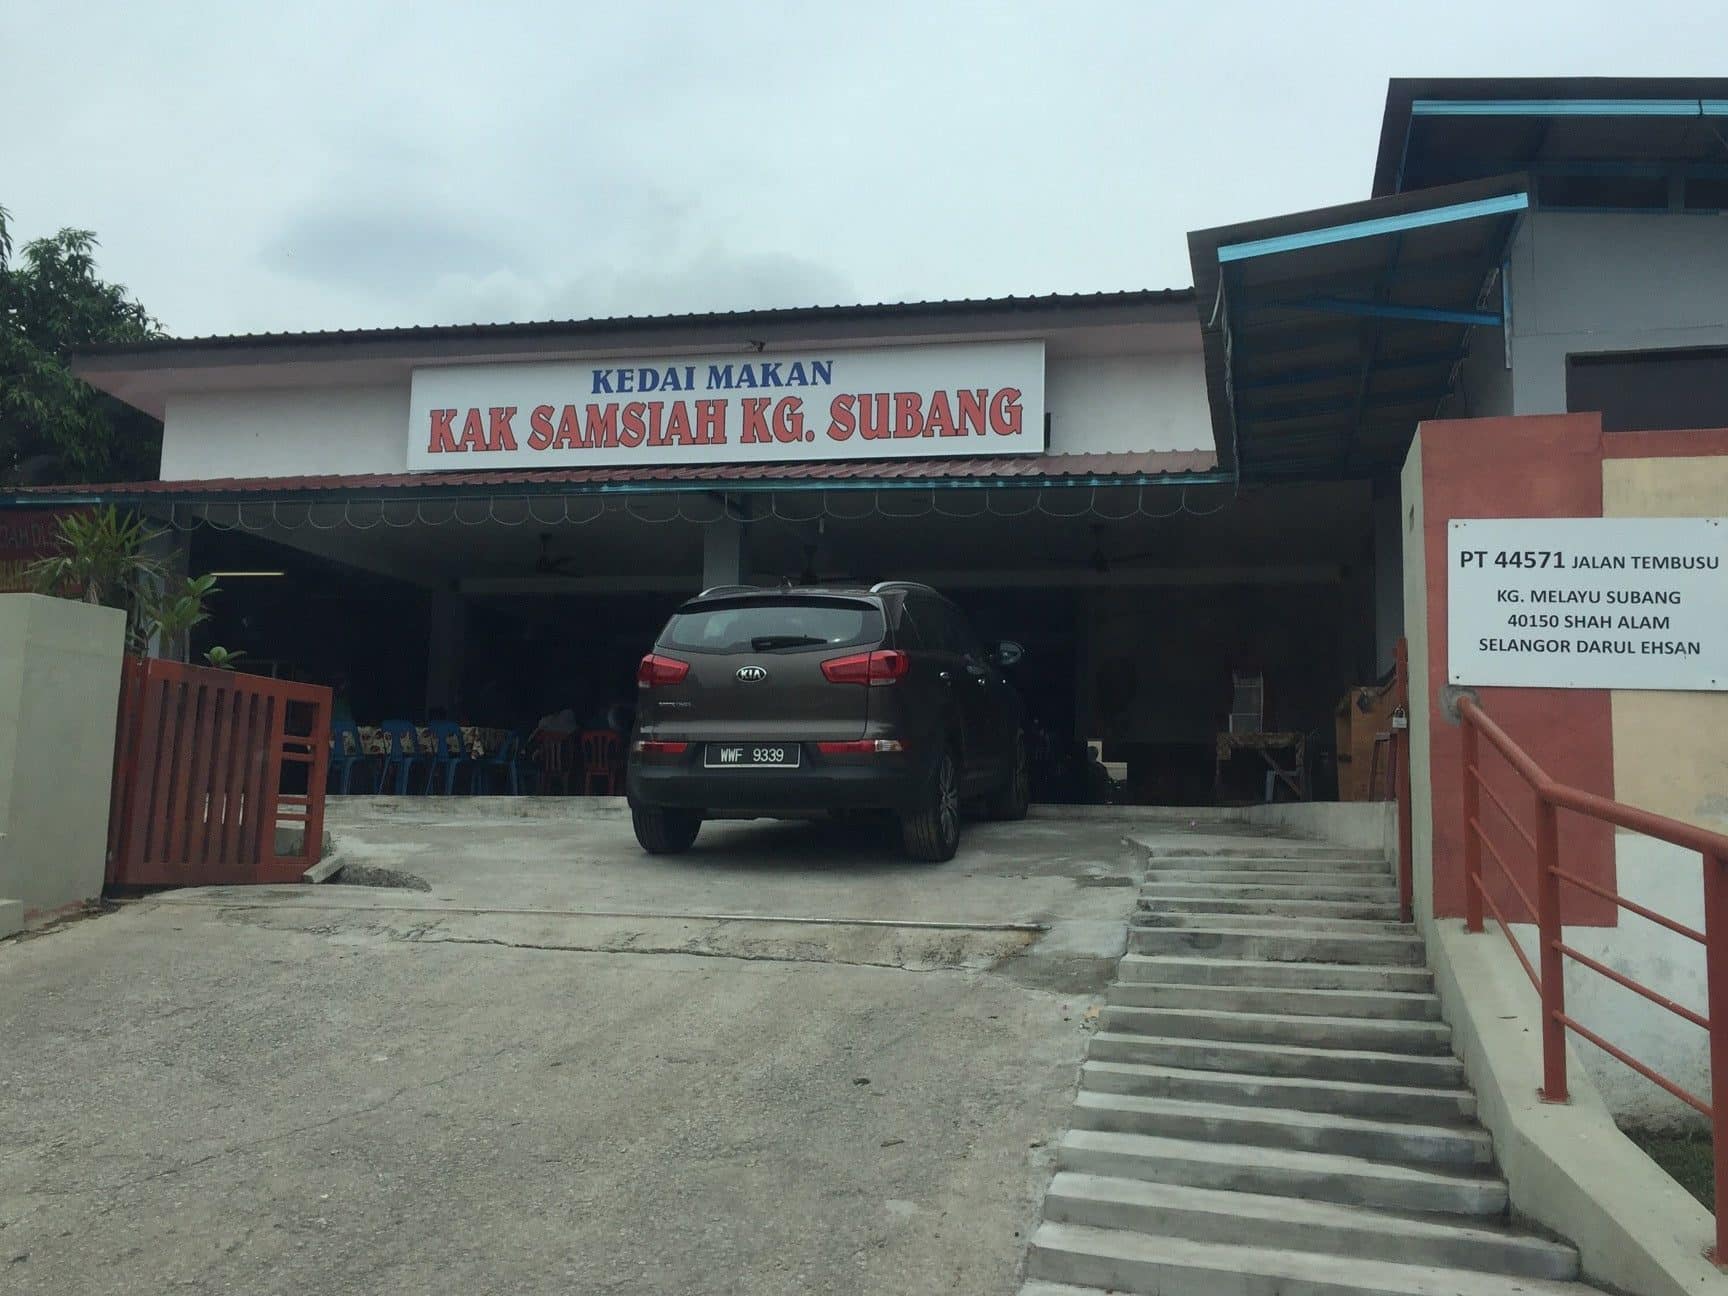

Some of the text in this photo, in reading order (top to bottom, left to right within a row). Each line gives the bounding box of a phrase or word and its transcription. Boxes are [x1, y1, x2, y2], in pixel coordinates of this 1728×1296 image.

[591, 360, 834, 394] KEDAI MAKAN
[427, 387, 1024, 452] KAK SAMSIAH KG. SUBANG
[1460, 551, 1719, 569] PT 44571 JALAN TEMBUSU
[1497, 589, 1682, 604] KG. MELAYU SUBANG
[1507, 614, 1670, 629] 40150 SHAH ALAM
[1479, 638, 1700, 655] SELANGOR DARUL EHSAN
[740, 669, 761, 681] KIA
[720, 748, 784, 762] WWF 9339
